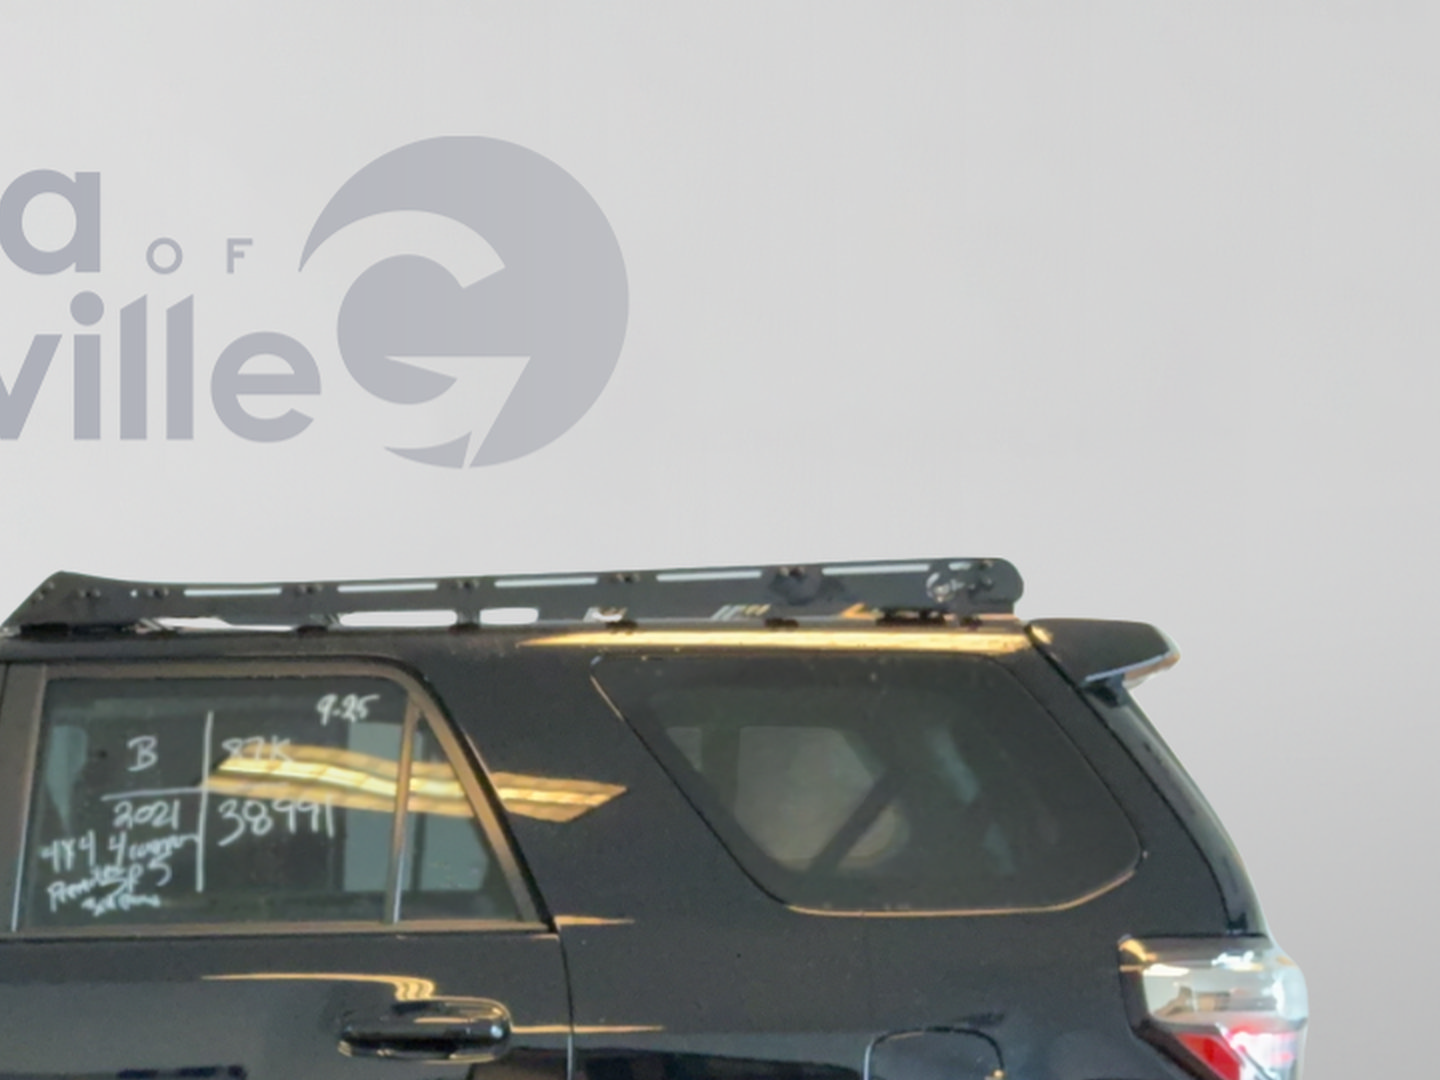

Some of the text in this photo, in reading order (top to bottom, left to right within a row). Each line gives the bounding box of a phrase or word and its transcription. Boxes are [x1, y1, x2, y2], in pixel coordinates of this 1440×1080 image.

[146, 237, 254, 275] OF
[126, 735, 158, 772] B
[113, 799, 180, 830] 2021
